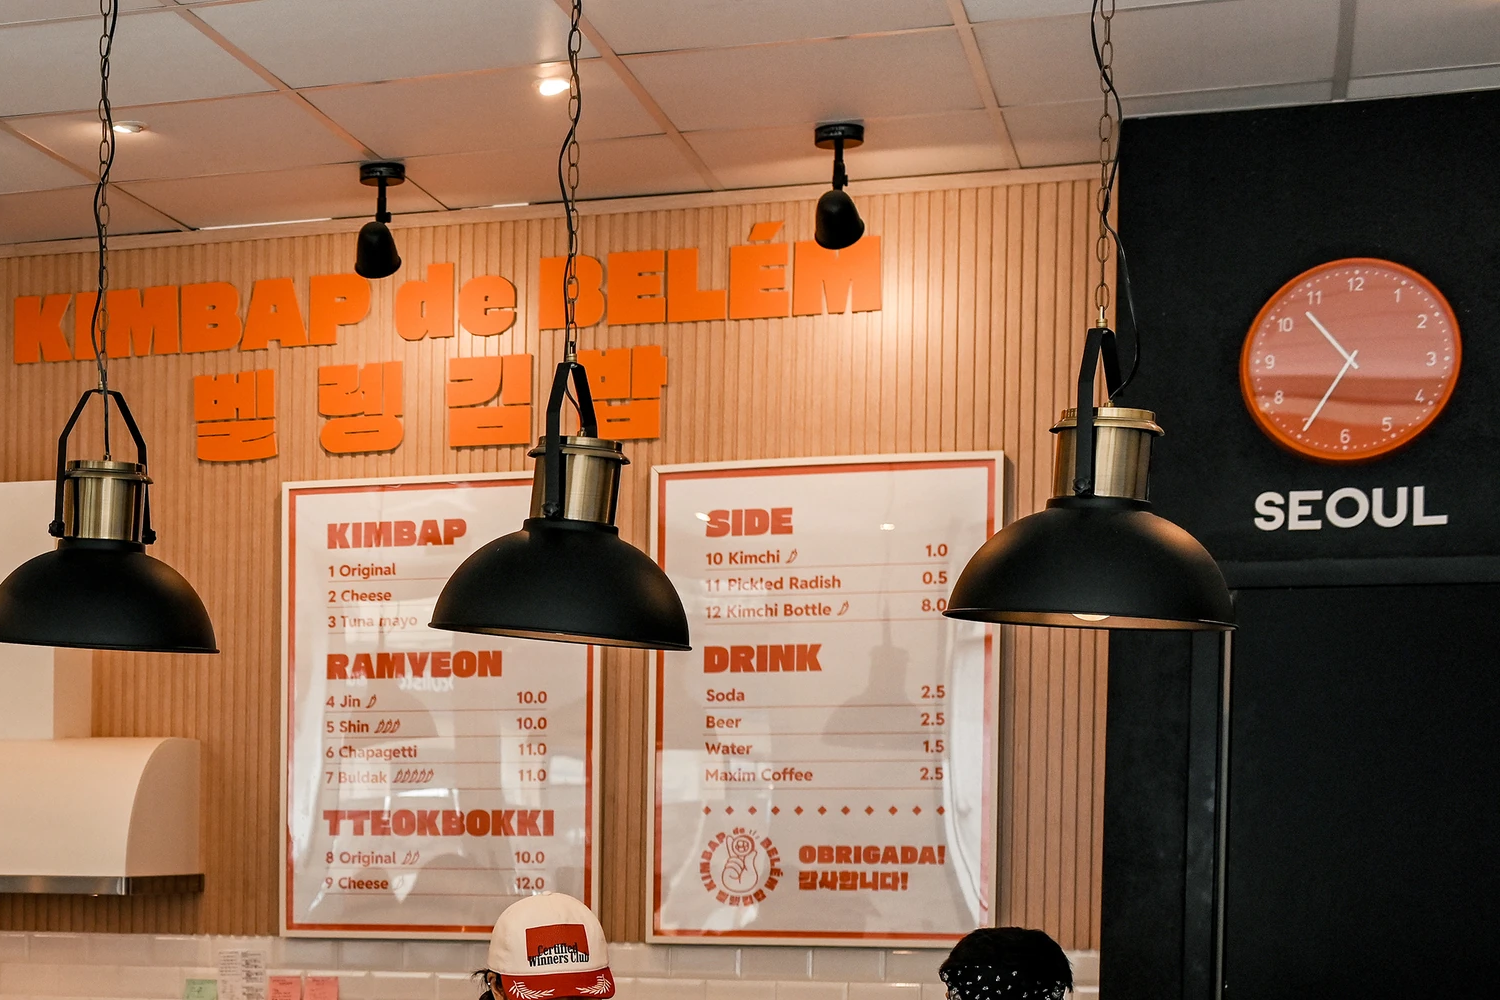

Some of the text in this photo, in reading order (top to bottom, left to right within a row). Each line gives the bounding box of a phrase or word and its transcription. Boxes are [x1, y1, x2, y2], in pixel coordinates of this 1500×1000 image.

[1348, 277, 1364, 291] 12
[13, 221, 883, 364] KIMBAP de BELÉM
[1307, 291, 1322, 305] 11
[1394, 289, 1400, 302] 1
[1277, 318, 1293, 332] 10
[1417, 315, 1428, 329] 2
[1265, 355, 1275, 369] 9
[1426, 352, 1437, 366] 3
[1274, 391, 1284, 405] 8
[1415, 389, 1424, 403] 4
[1382, 417, 1392, 432] 5
[1340, 429, 1350, 444] 6
[1254, 486, 1448, 531] SEOUL
[705, 507, 794, 538] SIDE
[327, 518, 467, 549] KIMBAP
[705, 543, 948, 565] 10 Kimchi 1.0
[329, 562, 396, 580] 1 Original
[705, 571, 947, 592] 11 Pickled Radish 0.5
[328, 588, 392, 603] 2 Cheese
[705, 598, 947, 619] 12 Kimchi Bottle 8.0
[328, 614, 417, 632] 3 Tuna mayo
[327, 650, 502, 680] RAMYEON
[703, 643, 822, 674] DRINK
[326, 691, 547, 708] 4 Jin 10.0
[706, 685, 945, 702] Soda 2.5
[326, 717, 547, 733] 5 Shin 10.0
[706, 713, 945, 729] Beer 2.5
[326, 743, 547, 761] 6 Chapagetti 11.0
[705, 740, 944, 756] Water 1.5
[326, 769, 547, 784] 7 Buldak 11.0
[705, 766, 944, 782] Maxim Coffee 2.5
[323, 809, 554, 837] TTEOKBOKKI
[326, 849, 545, 867] 8 Original 10.0
[799, 845, 945, 864] OBRIGADA!
[326, 876, 545, 890] 9 Cheese 12.0
[799, 870, 908, 891] 감사합니다!
[538, 943, 578, 956] Certified
[529, 951, 590, 967] Winners Club
